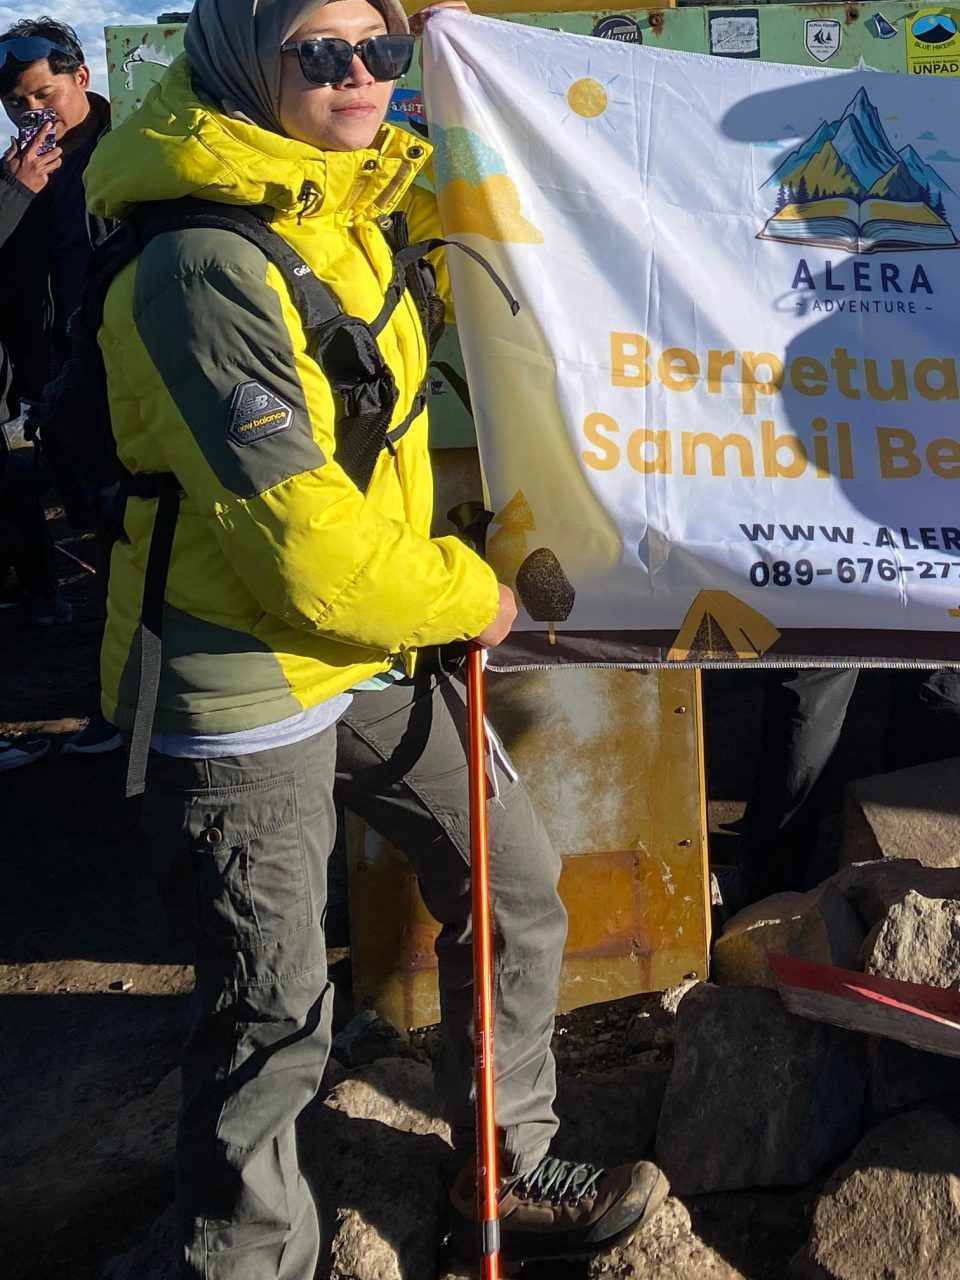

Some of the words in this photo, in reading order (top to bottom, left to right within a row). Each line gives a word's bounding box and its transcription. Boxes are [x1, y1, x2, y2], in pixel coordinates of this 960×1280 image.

[914, 41, 931, 50] BLUE
[932, 39, 956, 50] HIKERS
[913, 63, 960, 75] UNPAD
[791, 258, 934, 295] ALERA
[812, 299, 916, 314] ADVENTURE
[253, 411, 287, 427] balance
[582, 412, 855, 480] Sambil
